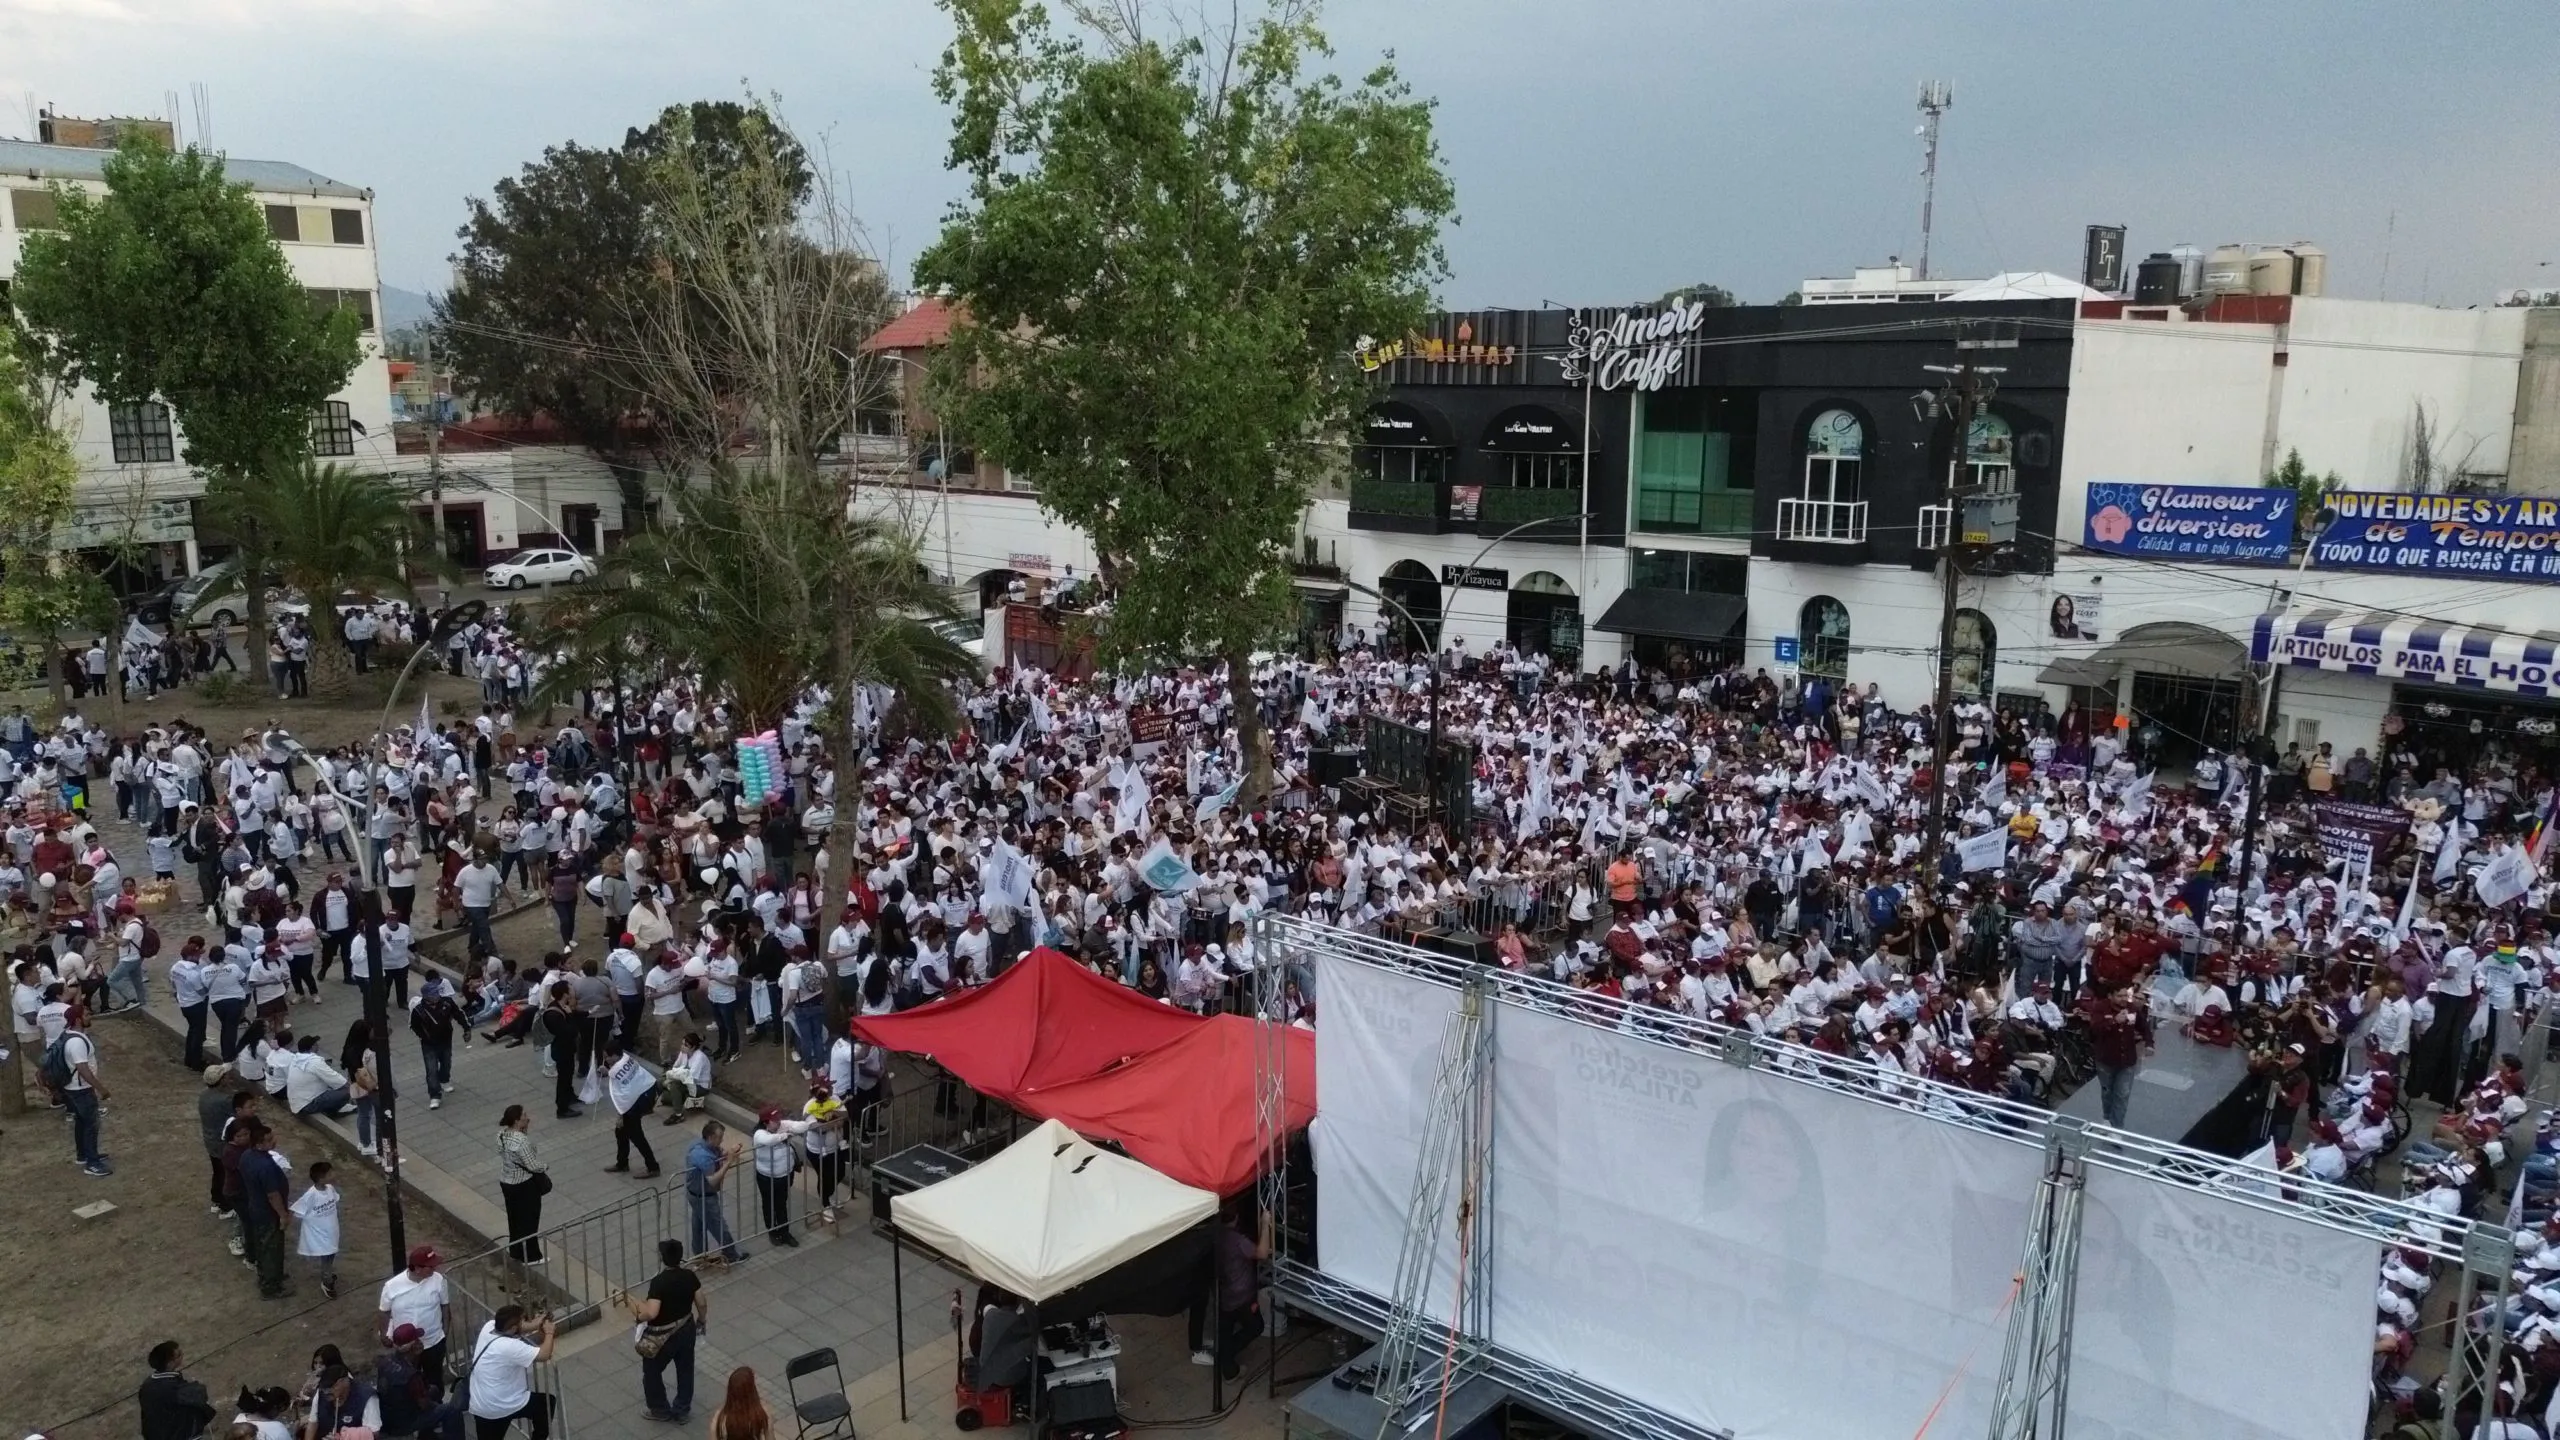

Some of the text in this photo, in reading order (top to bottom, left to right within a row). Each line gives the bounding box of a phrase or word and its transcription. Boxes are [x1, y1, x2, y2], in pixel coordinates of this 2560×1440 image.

[1590, 296, 1704, 361] Amore
[1600, 337, 1684, 391] Caffé
[2141, 487, 2290, 520] Glamour y
[2323, 493, 2492, 523] NOVEDADES
[2515, 500, 2560, 527] AR
[2136, 510, 2270, 539] diversion
[2365, 520, 2407, 543] de
[2137, 535, 2175, 552] Calidad
[2179, 541, 2191, 552] en
[2320, 543, 2363, 561] TODO
[2367, 546, 2390, 564] LO
[2396, 547, 2430, 566] QUE
[2436, 550, 2504, 571] BUSCAS
[2510, 554, 2536, 573] EN
[1465, 573, 1502, 587] Tizayuca
[1781, 642, 1791, 657] E
[2395, 651, 2445, 674] PARA
[2453, 658, 2477, 677] EL
[2319, 824, 2371, 841] APOYA A
